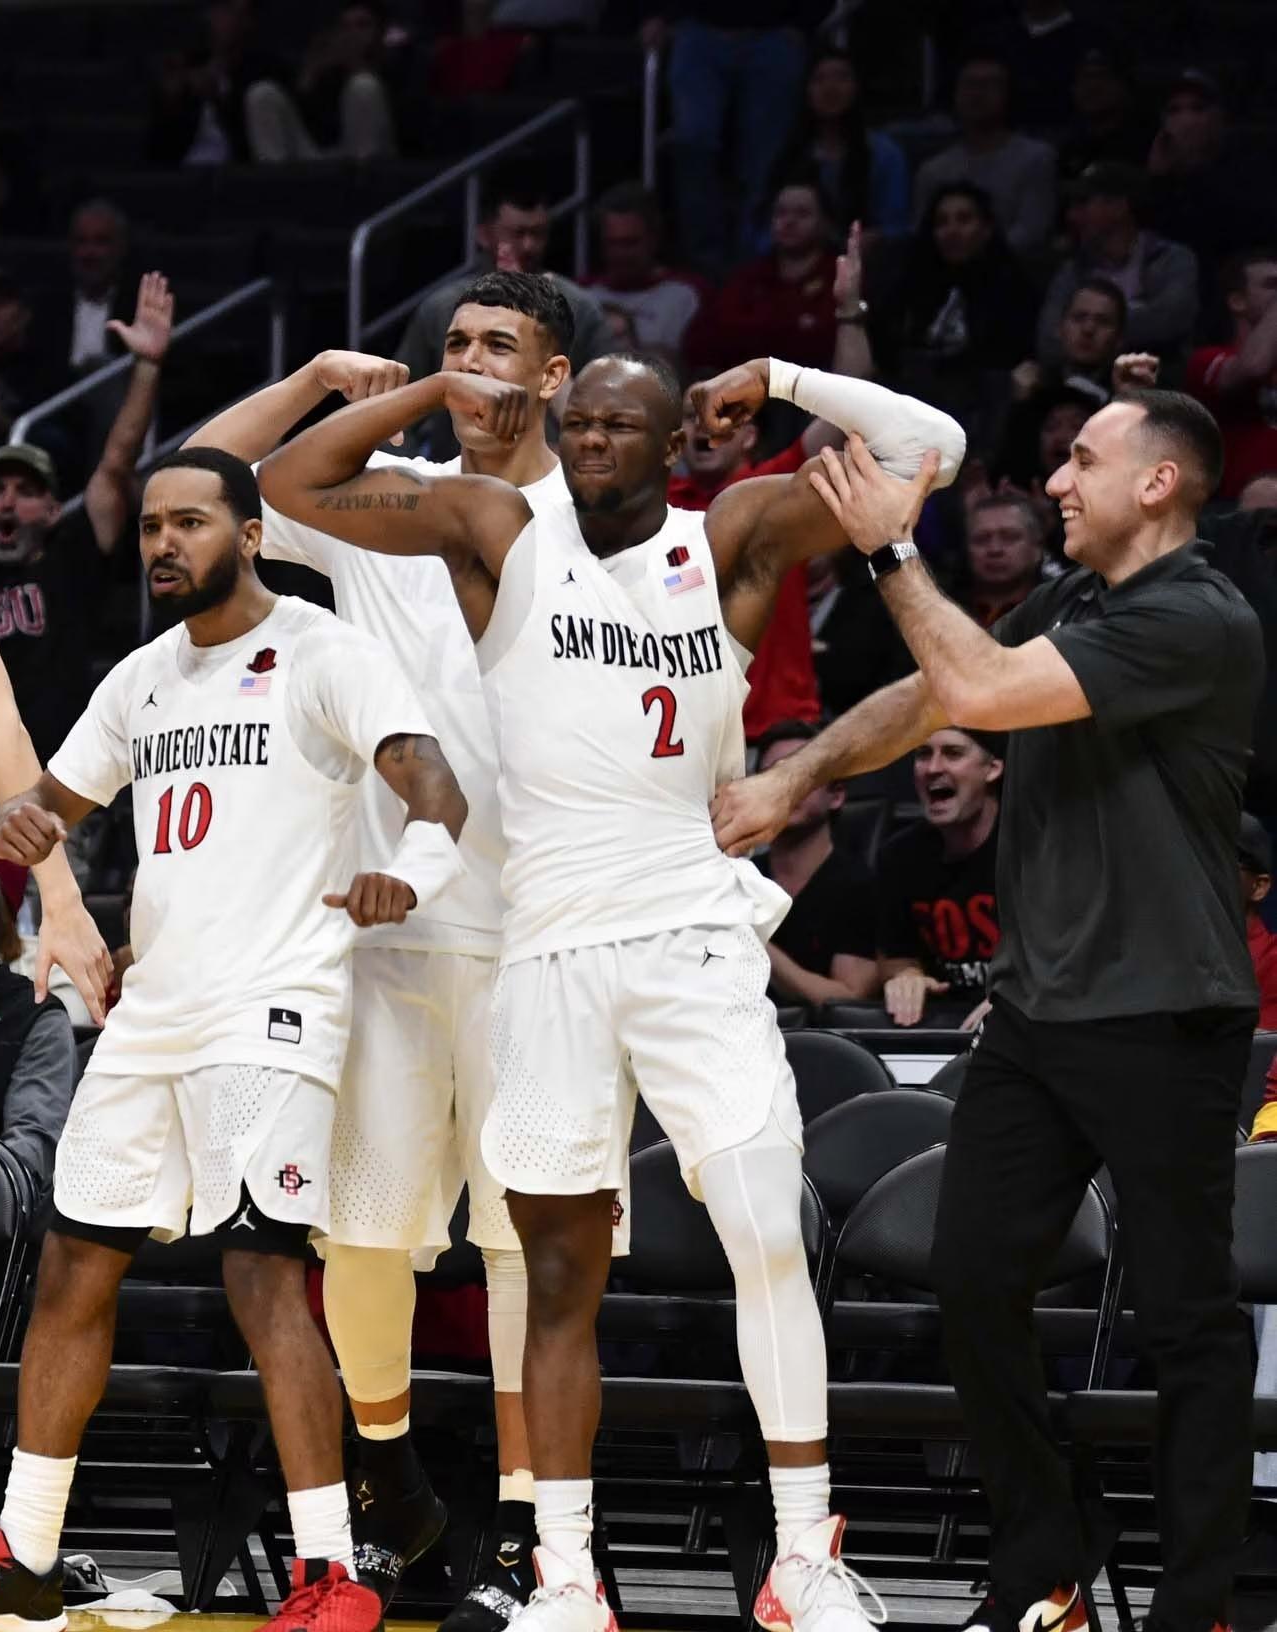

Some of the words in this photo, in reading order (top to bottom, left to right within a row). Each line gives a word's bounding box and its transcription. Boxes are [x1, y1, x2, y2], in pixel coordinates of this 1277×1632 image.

[550, 614, 596, 660] SAN
[641, 685, 685, 758] 2
[154, 724, 205, 775] DIEGO
[207, 722, 270, 767] STATE
[152, 781, 213, 855] 10
[282, 1010, 292, 1025] L
